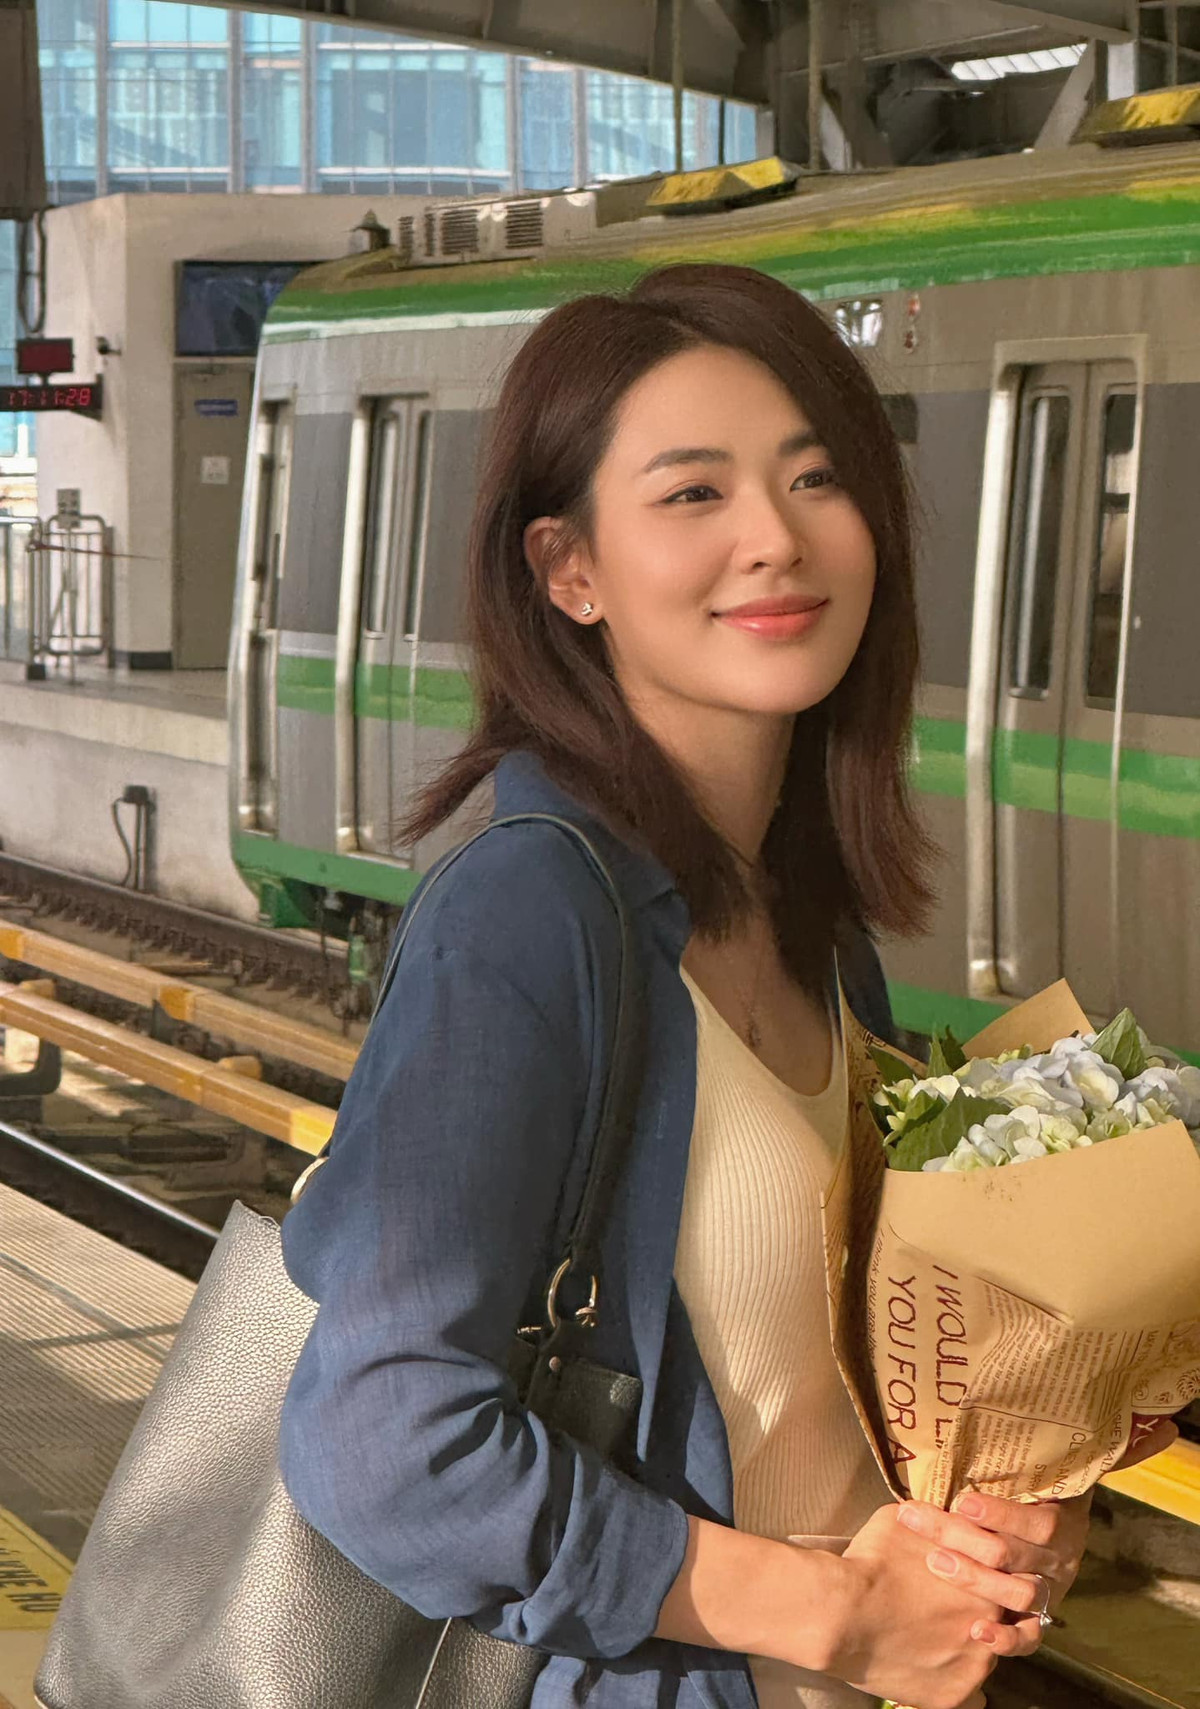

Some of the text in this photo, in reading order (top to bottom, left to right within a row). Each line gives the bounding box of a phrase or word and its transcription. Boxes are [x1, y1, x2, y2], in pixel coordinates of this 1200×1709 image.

[869, 1276, 877, 1307] you
[933, 1264, 959, 1281] I
[887, 1275, 917, 1464] YOU FOR A
[935, 1284, 969, 1407] WOULD
